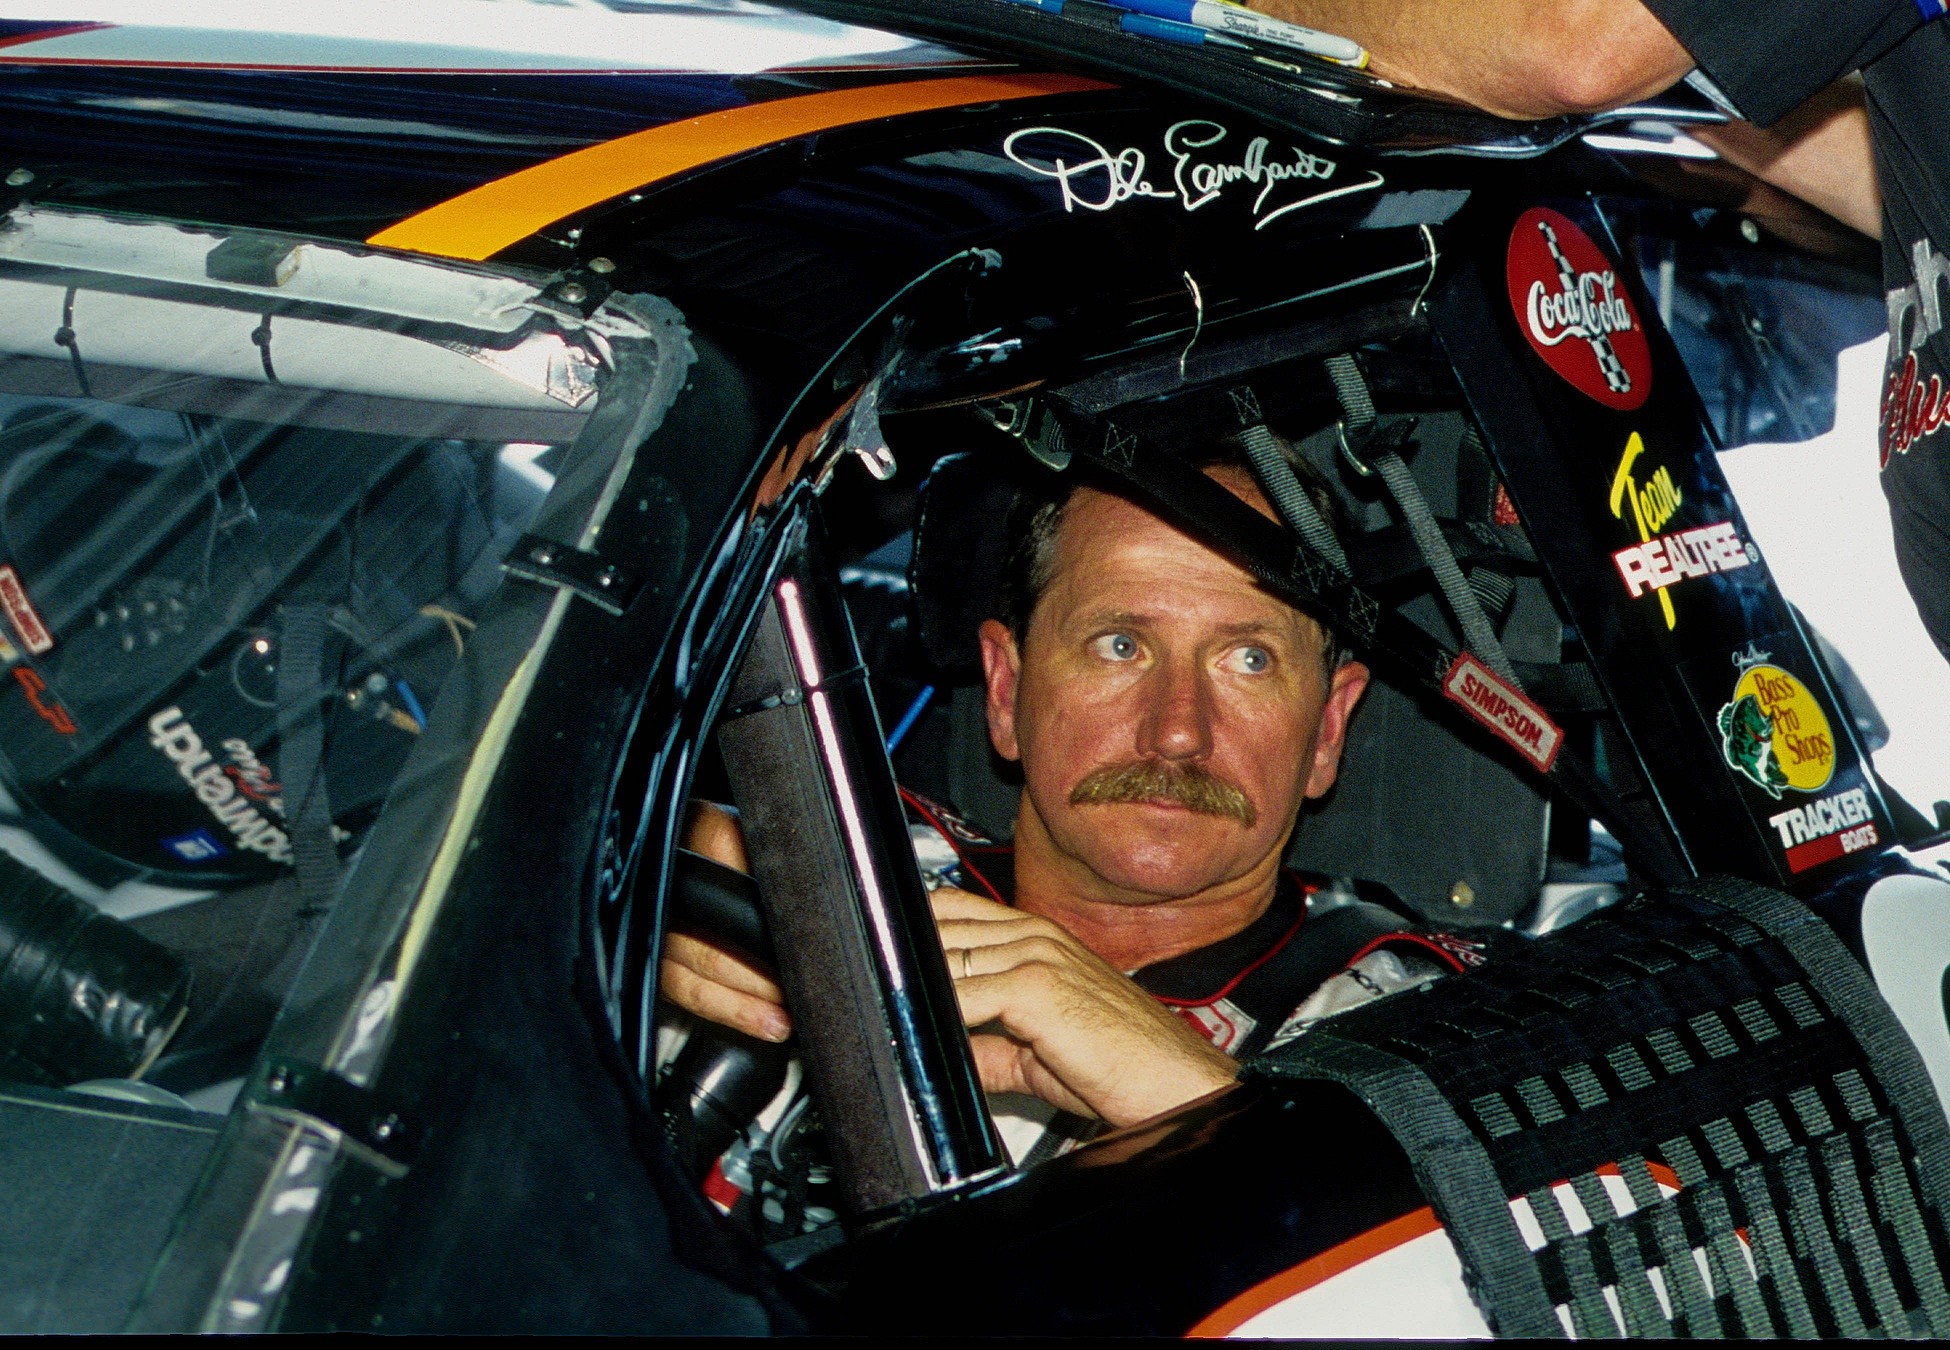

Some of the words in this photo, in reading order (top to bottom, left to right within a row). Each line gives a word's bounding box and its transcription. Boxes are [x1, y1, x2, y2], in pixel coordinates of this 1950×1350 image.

[1609, 431, 1682, 631] Team
[1612, 520, 1750, 599] REALTREE
[1460, 672, 1543, 750] SIMPSON
[1753, 673, 1795, 706] Bass
[1770, 704, 1800, 735] Pro
[1784, 732, 1832, 766] Shops
[1769, 787, 1873, 849] TRACKER
[1840, 824, 1879, 853] BOATS
